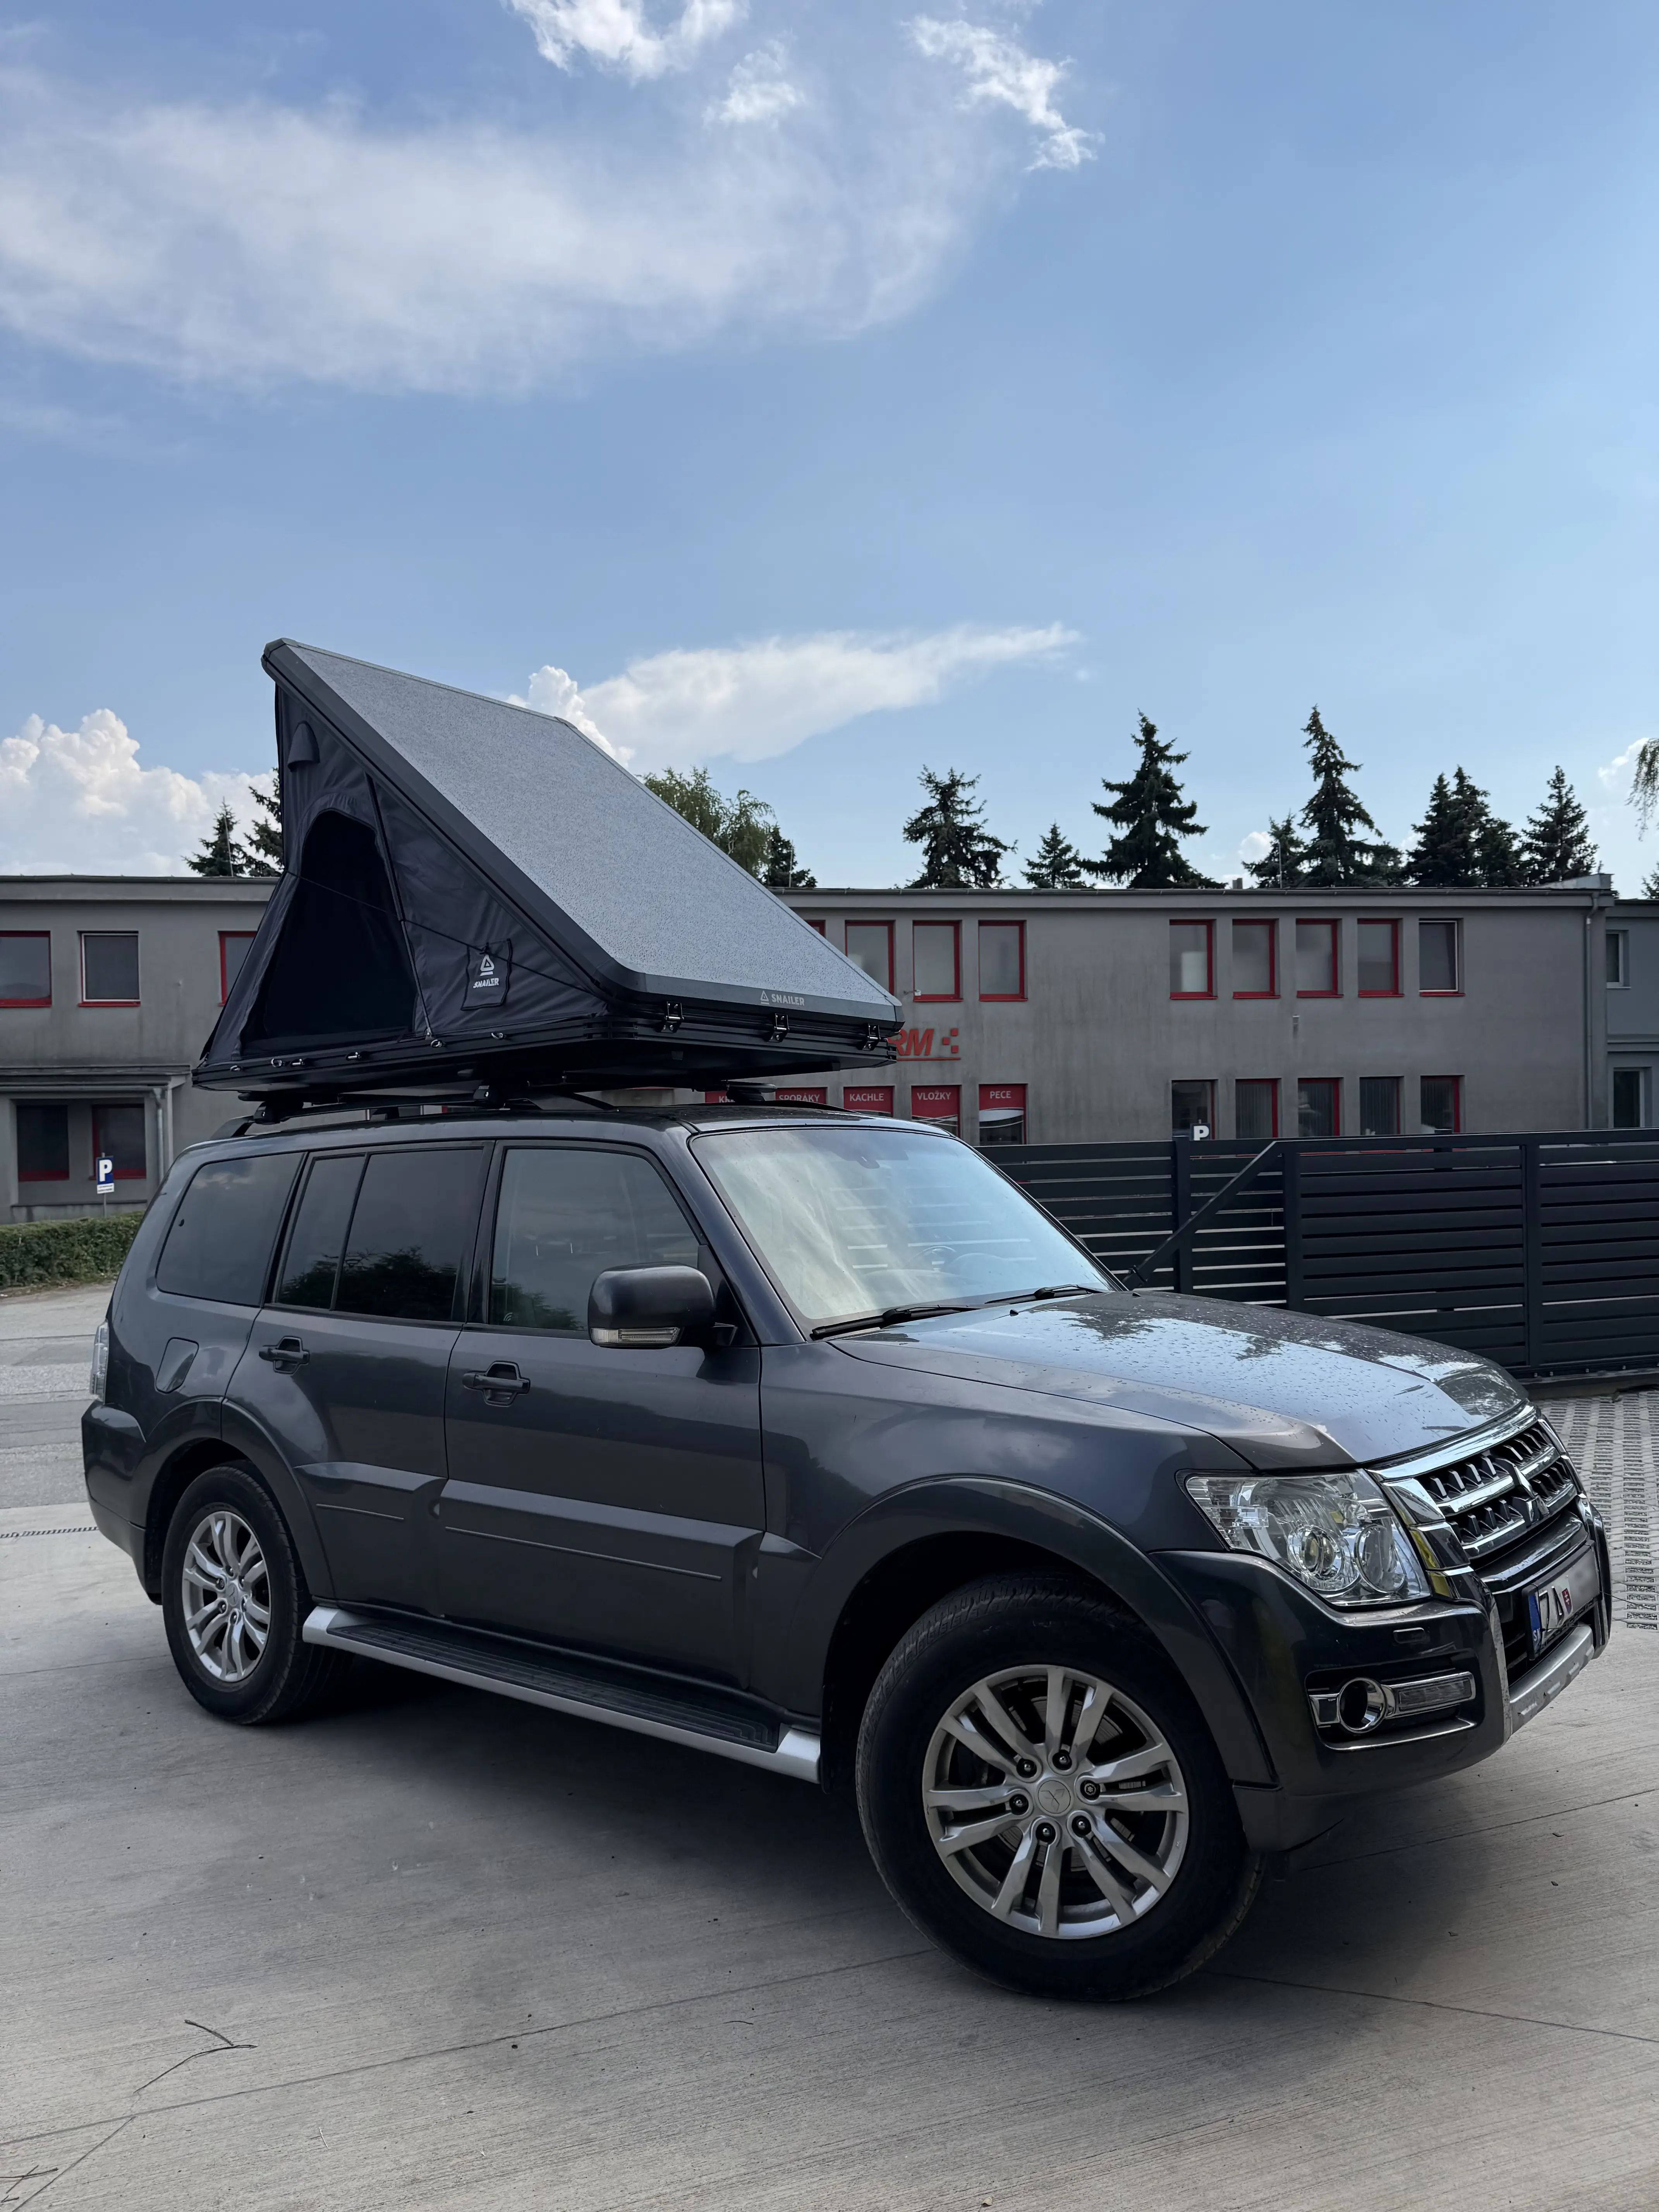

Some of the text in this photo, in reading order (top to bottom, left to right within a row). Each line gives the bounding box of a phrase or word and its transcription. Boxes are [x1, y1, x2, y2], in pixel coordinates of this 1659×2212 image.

[473, 977, 499, 988] SNAILER
[771, 993, 805, 1006] SNAILER
[779, 1092, 820, 1103] SPORÁKY
[850, 1093, 884, 1101] KACHLE
[917, 1090, 951, 1100] VLOŽKY
[990, 1091, 1012, 1099] PECE
[1194, 1125, 1209, 1141] P
[99, 1159, 112, 1182] P
